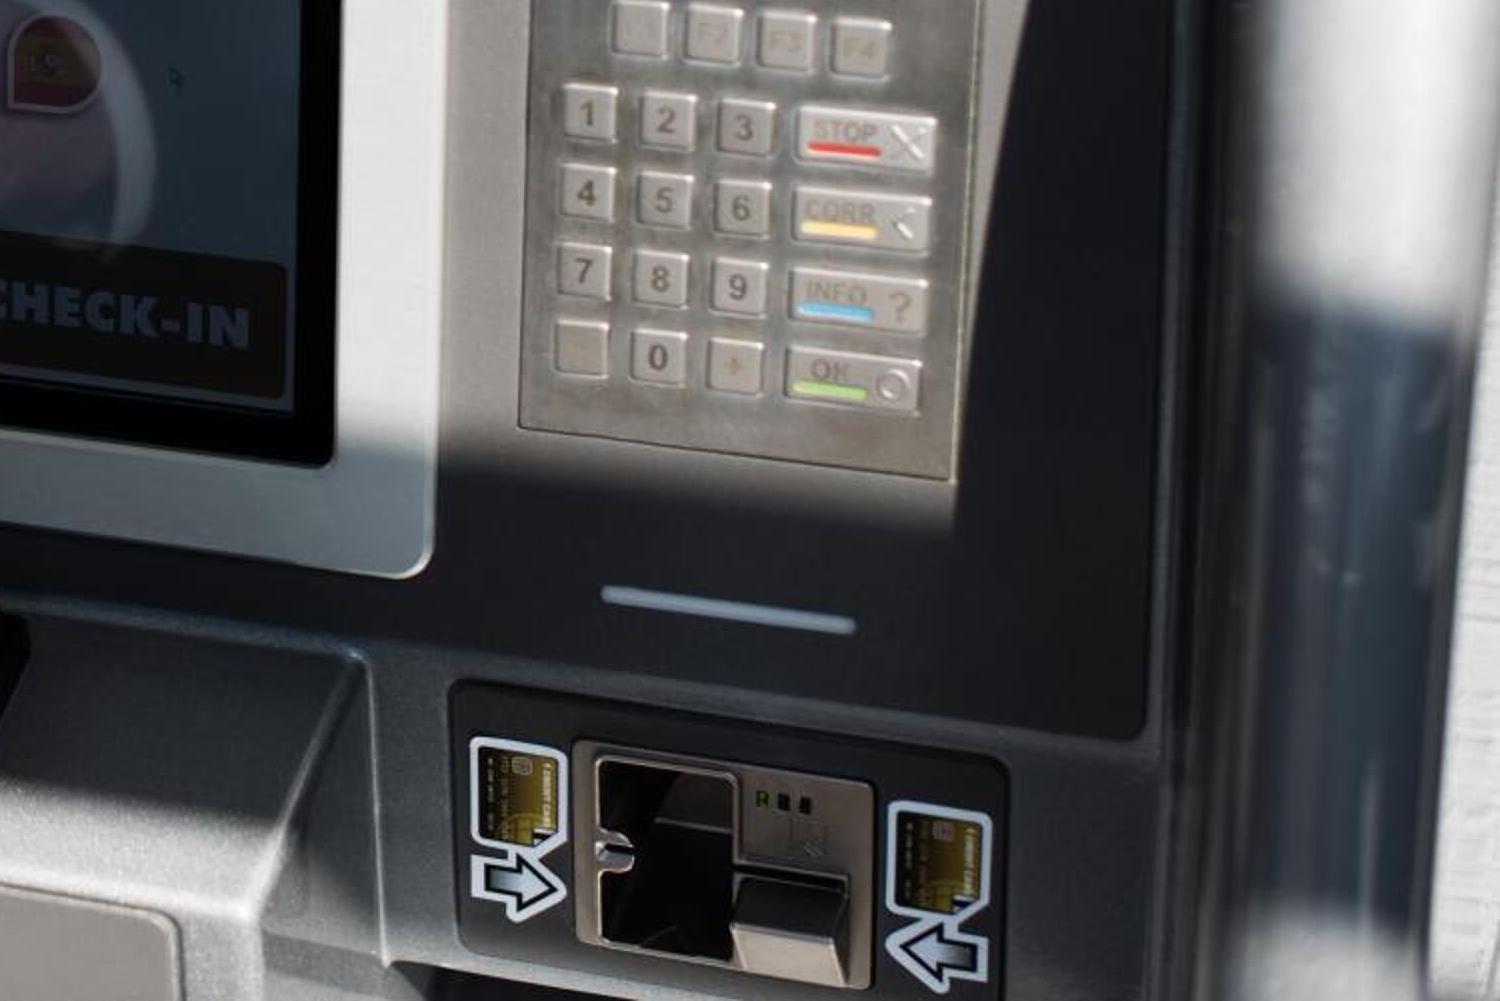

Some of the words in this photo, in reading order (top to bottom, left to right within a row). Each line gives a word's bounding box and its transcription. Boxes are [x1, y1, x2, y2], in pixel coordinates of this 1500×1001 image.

[580, 101, 594, 127] 1
[658, 107, 676, 134] 2
[735, 114, 754, 141] 3
[812, 118, 877, 144] STOP
[577, 180, 596, 206] 4
[655, 186, 673, 213] 5
[733, 195, 751, 221] 6
[804, 200, 876, 225] CORR
[575, 257, 593, 283] 7
[651, 266, 670, 293] 8
[729, 274, 748, 300] 9
[806, 280, 868, 305] INFO
[648, 344, 668, 370] 0
[811, 357, 848, 381] OK
